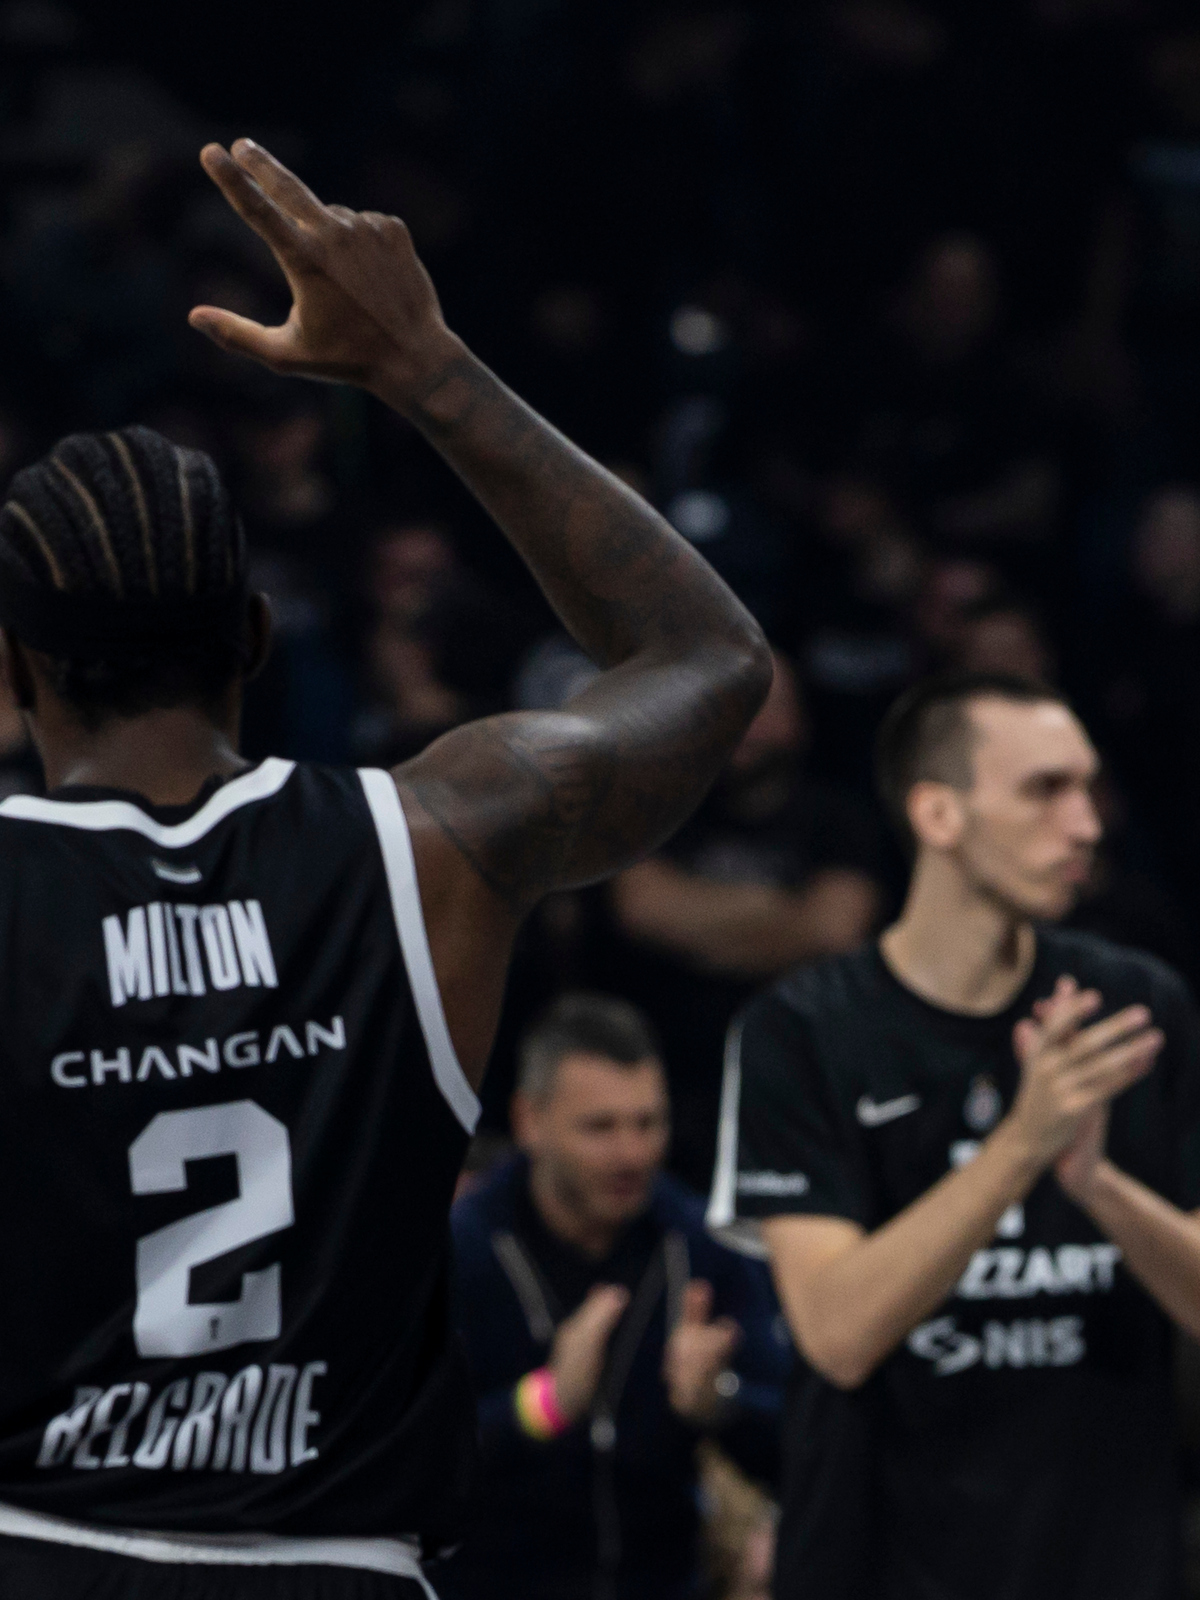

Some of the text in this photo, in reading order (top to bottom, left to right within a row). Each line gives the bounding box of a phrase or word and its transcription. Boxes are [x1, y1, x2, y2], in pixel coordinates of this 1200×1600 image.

[102, 899, 279, 1007] MILTON
[51, 1016, 347, 1088] CHANGAN
[128, 1100, 295, 1358] 2
[36, 1361, 328, 1475] BELGRADE
